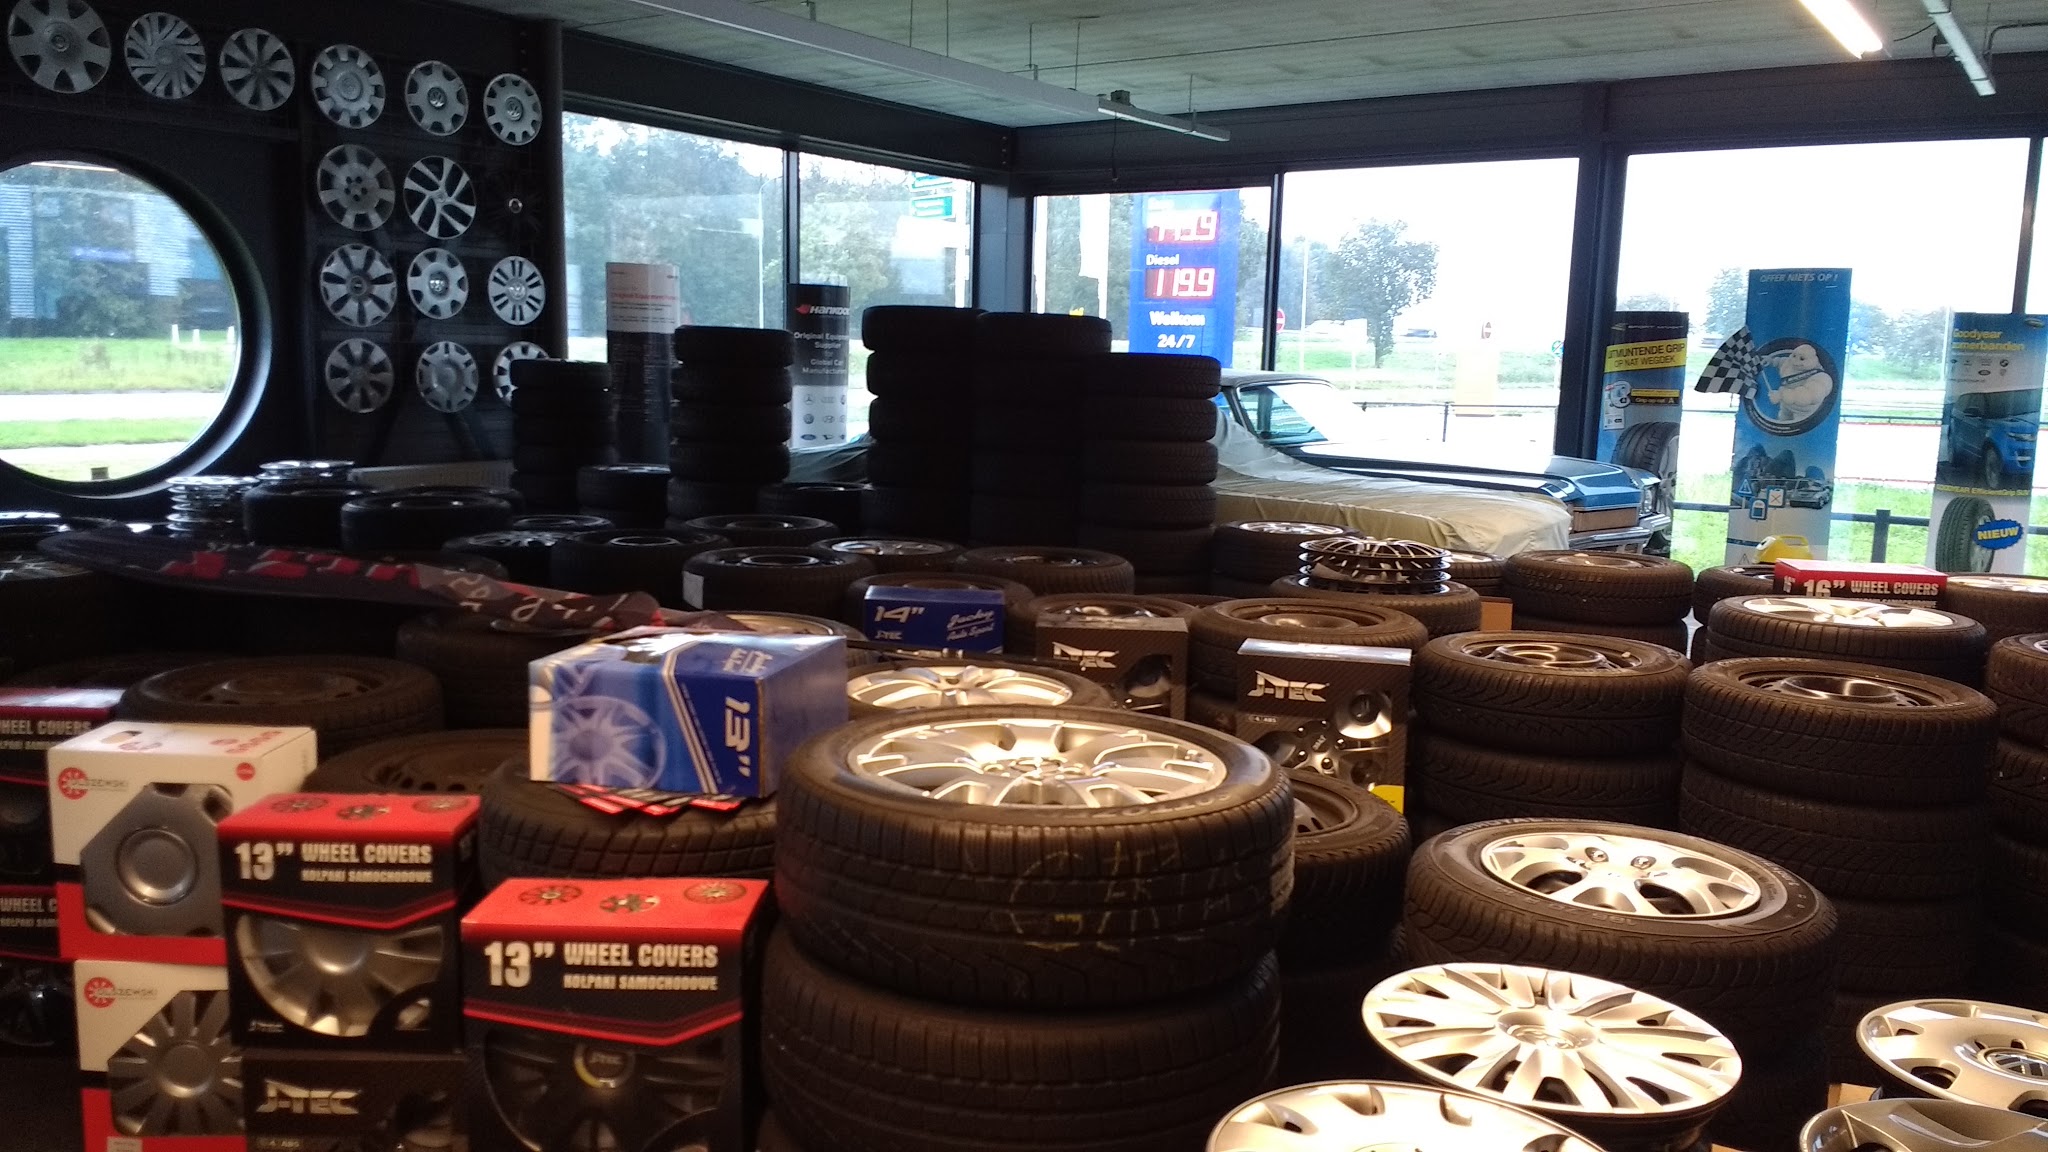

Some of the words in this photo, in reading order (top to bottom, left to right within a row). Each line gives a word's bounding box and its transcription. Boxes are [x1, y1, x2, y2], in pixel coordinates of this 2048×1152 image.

[1146, 254, 1180, 266] Diesel
[1787, 273, 1815, 282] NIETS
[1149, 311, 1206, 326] Welkom
[793, 331, 824, 341] Original
[1157, 334, 1196, 348] 24/7
[814, 341, 842, 350] Supplier
[1666, 342, 1686, 353] GRIP
[810, 358, 833, 366] Global
[1626, 357, 1639, 367] NAT
[1641, 354, 1677, 365] WEGDEK
[1977, 525, 2020, 540] NIEUW
[1850, 580, 1890, 594] WHEEL
[1893, 582, 1939, 596] COVERS
[874, 605, 925, 623] 14"
[1246, 669, 1330, 702] J-TEC
[0, 720, 33, 735] HEEL
[234, 842, 294, 881] 13"
[301, 842, 360, 863] WHEEL
[363, 843, 433, 864] COVERS
[0, 897, 44, 912] WHEEL
[484, 941, 555, 987] 13"
[563, 942, 633, 966] WHEEL
[638, 943, 718, 968] COVERS
[255, 1078, 364, 1114] J-TEC
